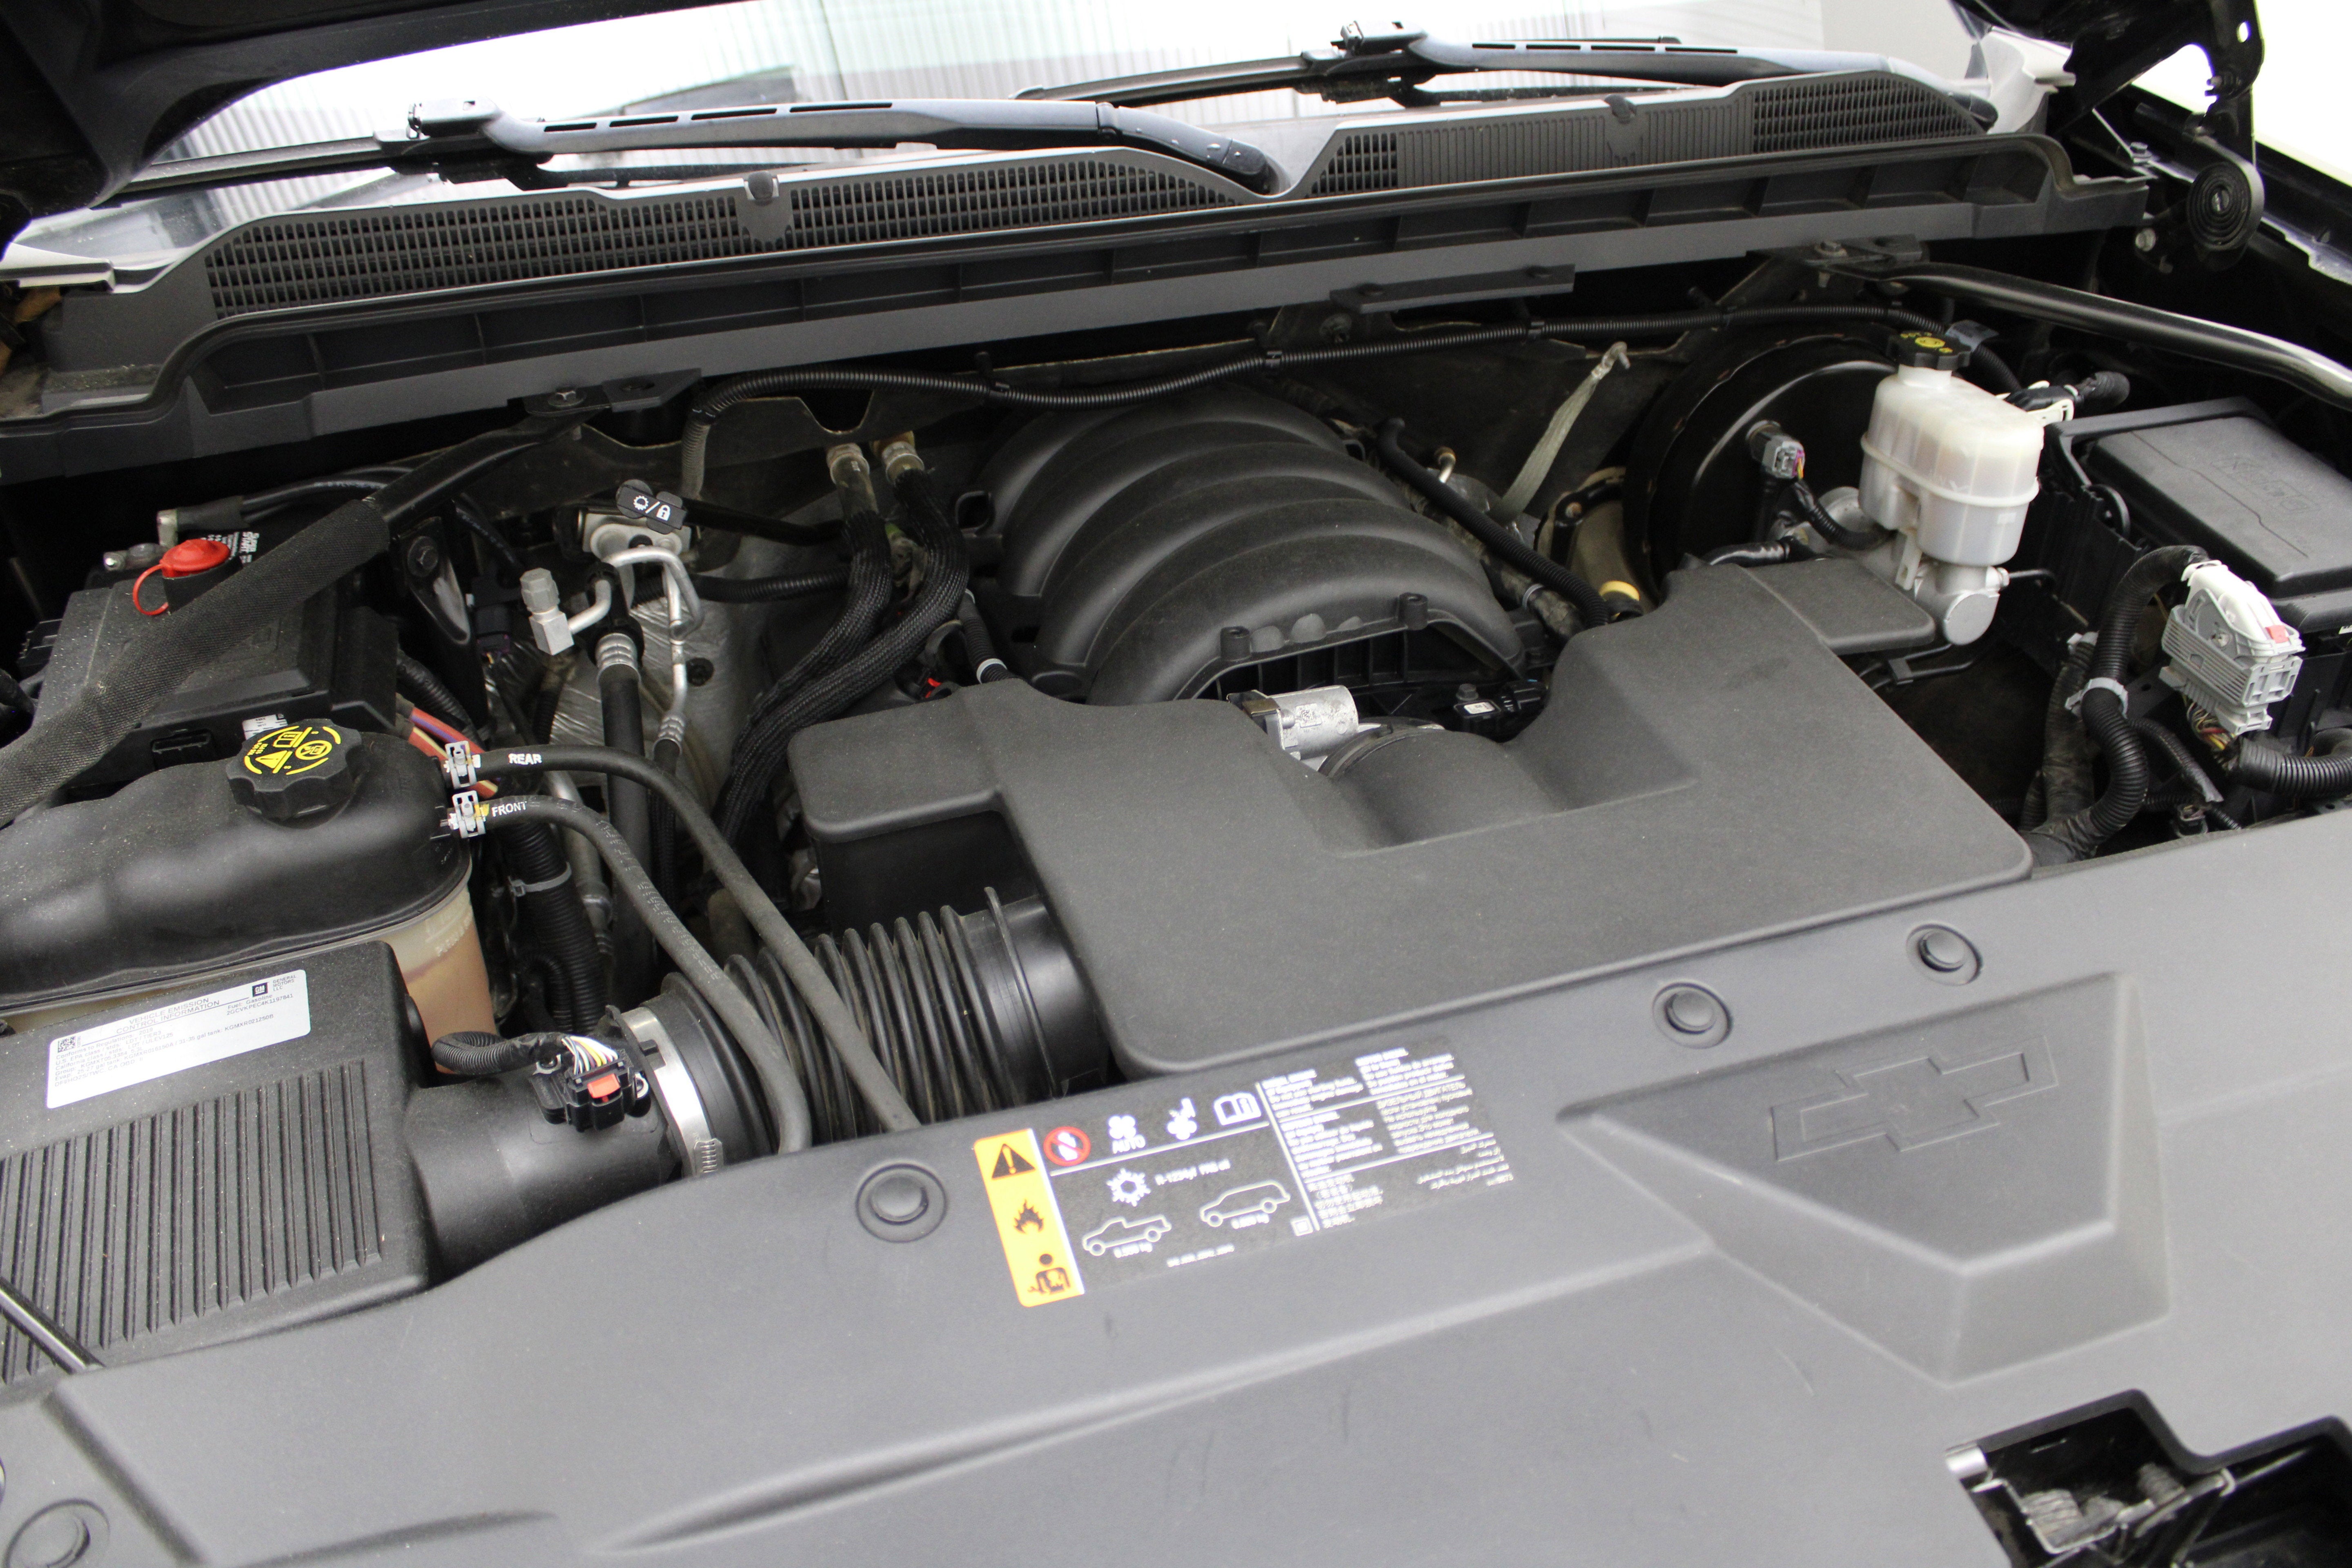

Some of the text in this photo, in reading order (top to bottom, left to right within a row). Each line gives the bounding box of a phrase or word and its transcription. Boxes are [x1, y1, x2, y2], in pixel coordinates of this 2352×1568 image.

[508, 753, 542, 765] REAR
[491, 801, 527, 817] FRONT
[273, 975, 296, 984] GENERAL
[273, 979, 294, 987] MOTORS
[246, 994, 273, 1004] Gasoline
[116, 1000, 220, 1034] CONTROL INFORMATION
[129, 998, 209, 1024] VEHICLE EMISSION
[85, 1049, 100, 1057] class
[144, 1031, 161, 1039] TIER3
[179, 1036, 195, 1045] 31-35
[56, 1048, 86, 1060] Conforms
[87, 1053, 103, 1061] class
[1112, 1135, 1146, 1154] AUTO
